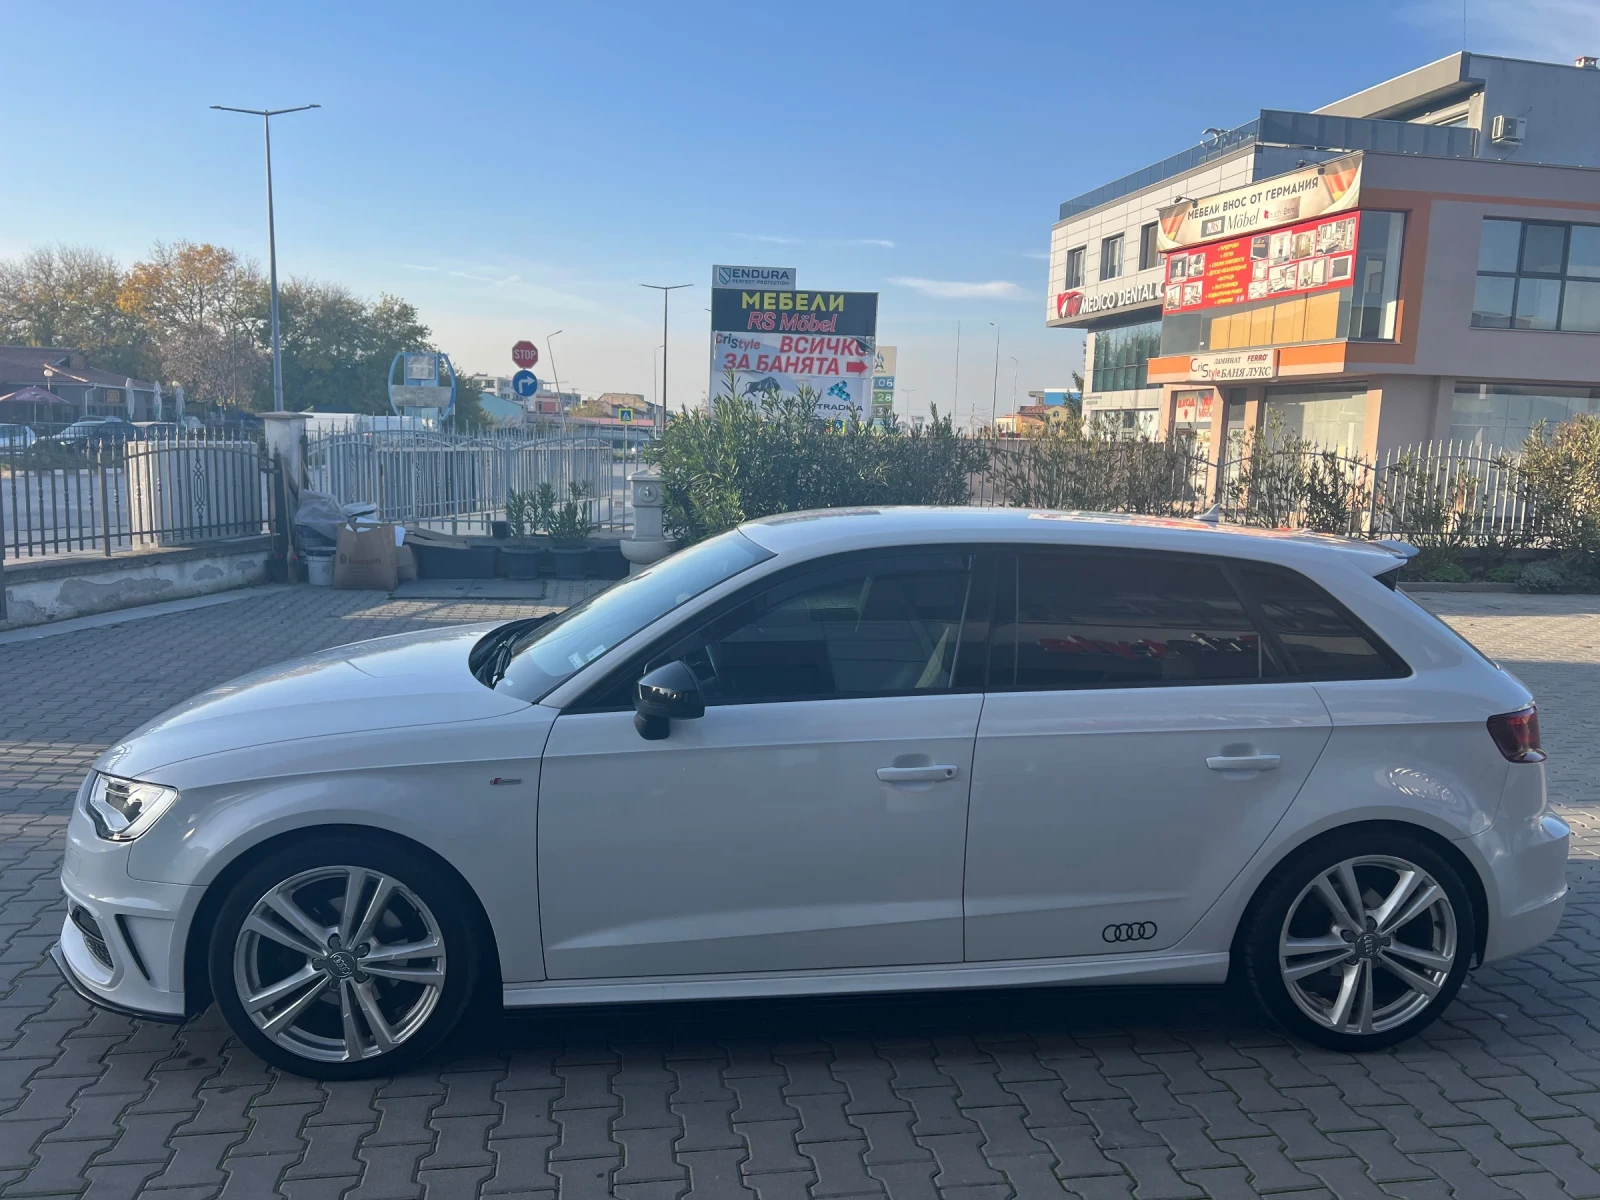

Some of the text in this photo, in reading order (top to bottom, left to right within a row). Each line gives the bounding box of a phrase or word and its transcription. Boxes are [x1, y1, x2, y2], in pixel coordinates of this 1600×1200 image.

[1187, 176, 1319, 221] МЕБЕЛИ ВНОС ОТ ГЕРМАНИЯ
[1226, 208, 1261, 231] Möbel
[732, 268, 790, 280] ENDURA
[741, 292, 844, 312] МЕБЕЛИ
[1079, 292, 1117, 315] MEDICO
[1117, 283, 1158, 307] DENTAL
[747, 312, 838, 333] RS Möbel
[514, 349, 536, 360] STOP
[723, 353, 840, 376] ЗА БАНЯТА
[1220, 366, 1272, 379] БАНЯ ЛУКС
